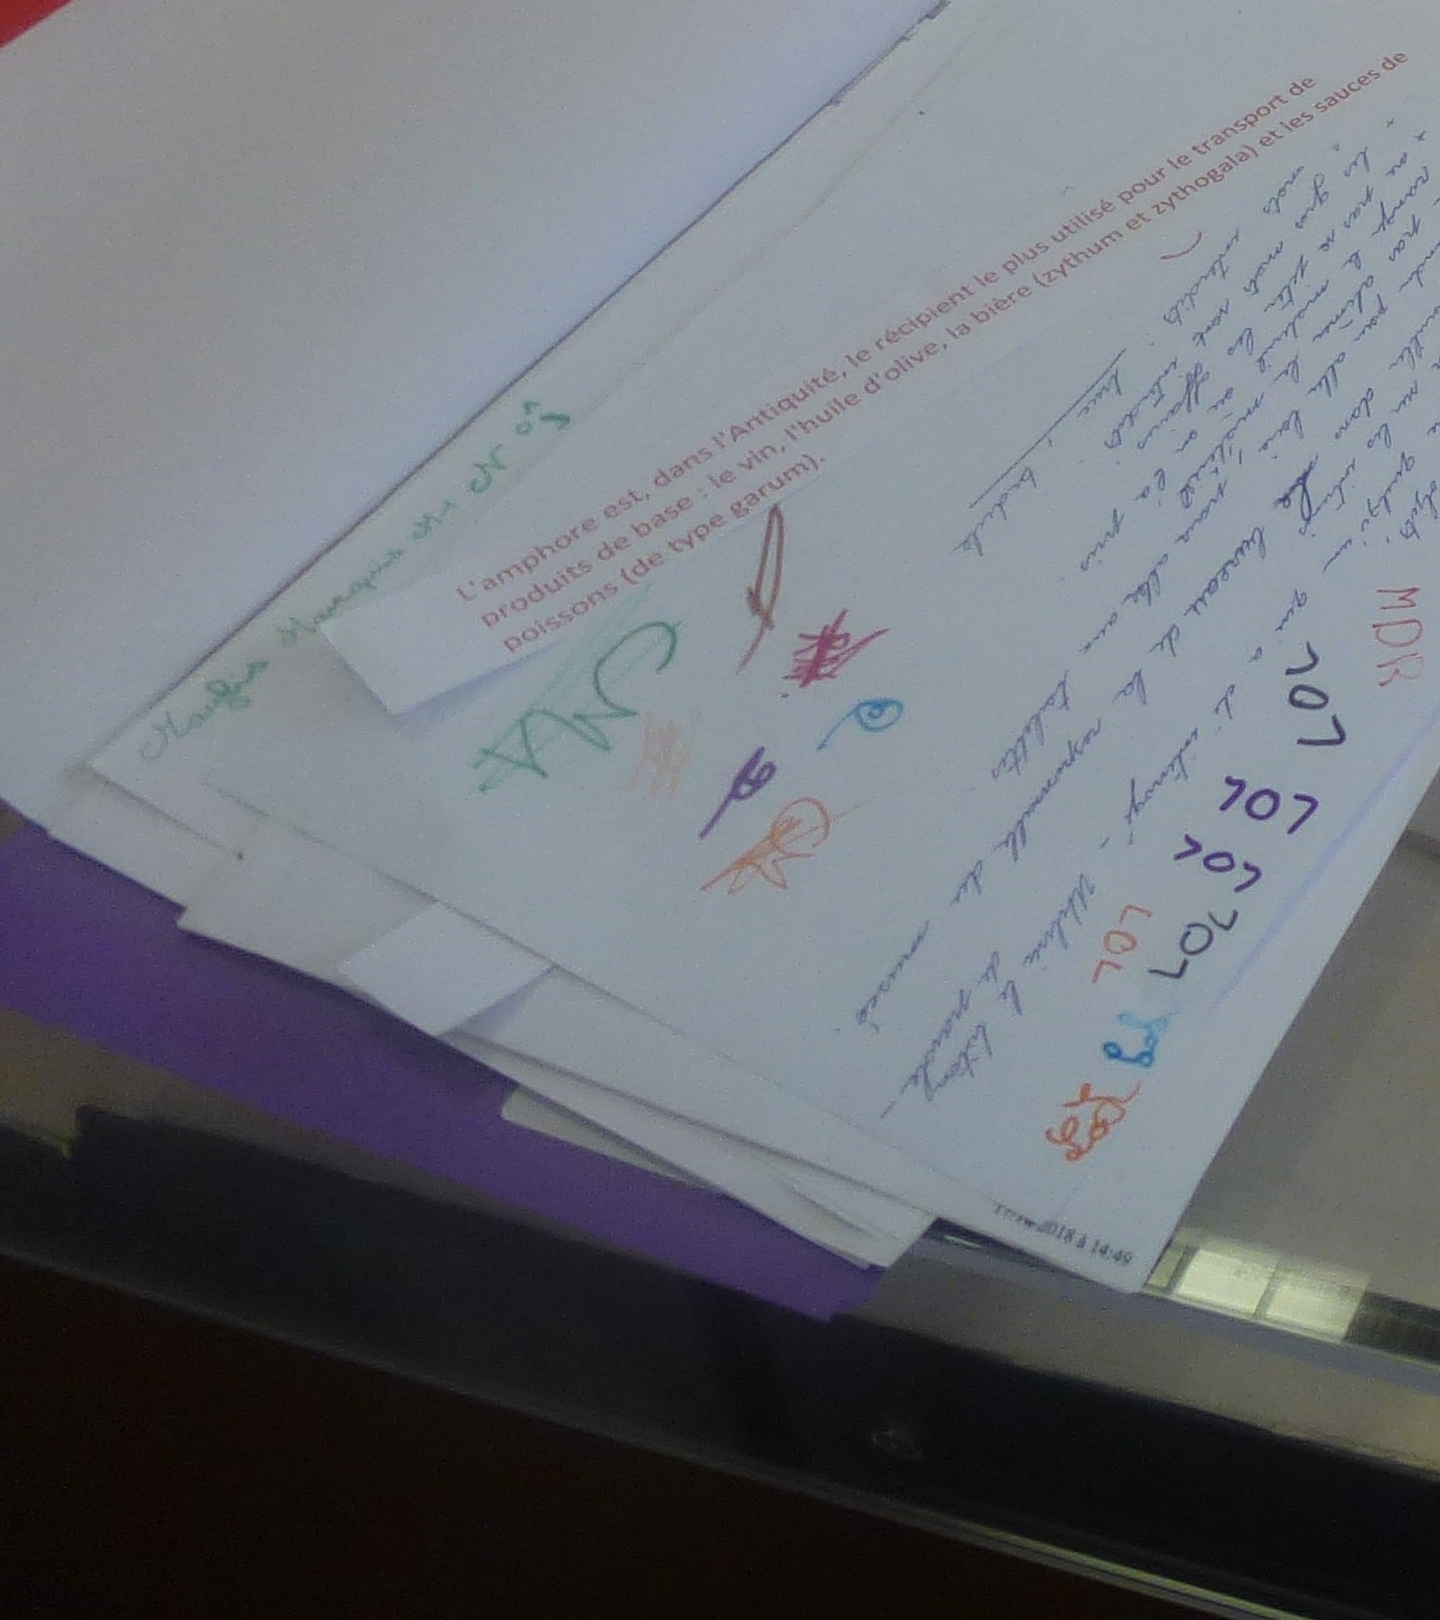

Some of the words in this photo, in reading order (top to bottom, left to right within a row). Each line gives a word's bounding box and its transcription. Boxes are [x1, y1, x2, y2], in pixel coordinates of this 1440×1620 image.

[455, 517, 597, 601] L'amphore
[602, 489, 650, 519] est,
[652, 447, 713, 487] dans
[843, 348, 872, 368] le
[874, 284, 975, 350] récipient
[972, 270, 1000, 288] le
[1000, 241, 1050, 276] plus
[1049, 198, 1116, 243] utilisé
[1116, 166, 1166, 205] pour
[1165, 154, 1192, 170] le
[1190, 94, 1289, 155] transport
[1288, 77, 1317, 96] de
[480, 560, 593, 628] produits
[596, 535, 631, 561] de
[629, 496, 692, 538] base
[707, 469, 737, 489] le
[736, 444, 786, 470] vin,
[863, 341, 947, 394] d'olive,
[944, 322, 971, 339] la
[969, 285, 1033, 324] bière
[1031, 229, 1124, 288] (zythum
[1124, 212, 1151, 231] et
[1150, 143, 1259, 215] zythogala)
[1258, 129, 1285, 147] et
[1278, 110, 1314, 132] les
[1313, 68, 1381, 113] sauces
[1380, 52, 1408, 71] de
[502, 582, 618, 652] poissons
[619, 551, 664, 585] (de
[667, 513, 725, 552] type
[729, 453, 825, 519] garum).
[1371, 586, 1422, 687] MDR
